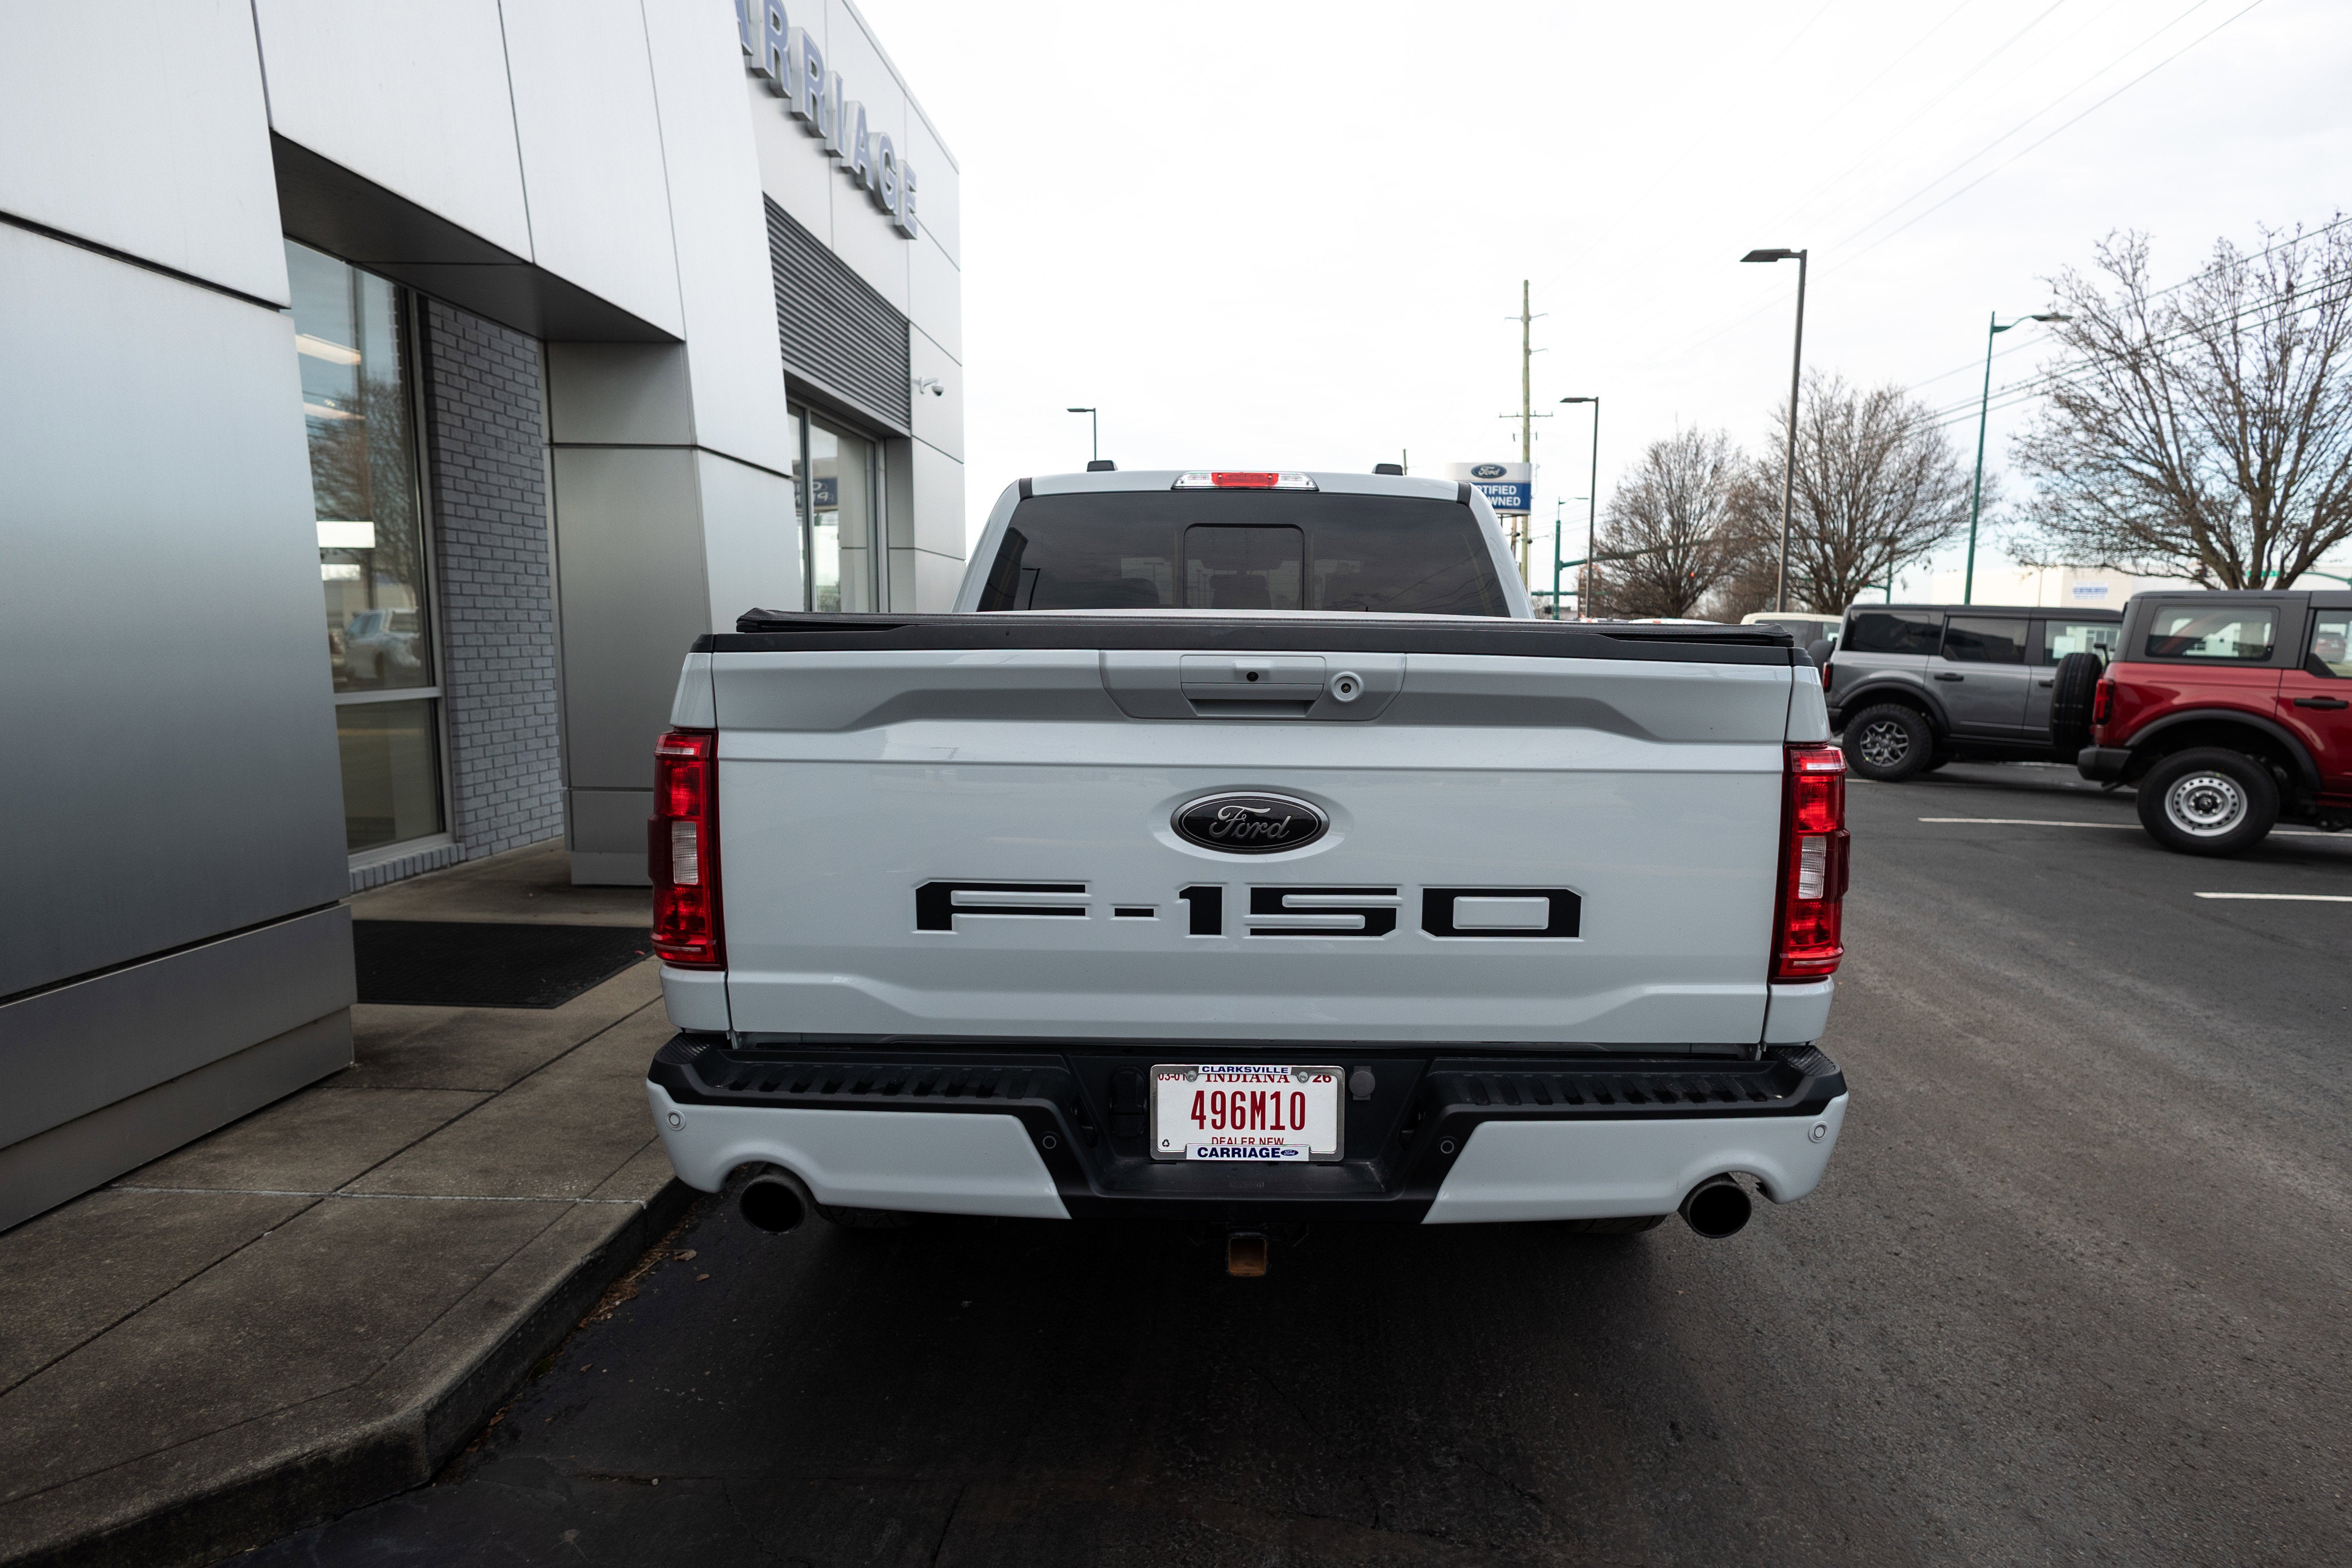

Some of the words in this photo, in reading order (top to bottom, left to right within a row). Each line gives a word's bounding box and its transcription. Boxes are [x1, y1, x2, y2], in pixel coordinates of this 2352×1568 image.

[1478, 466, 1501, 476] Ford
[1209, 805, 1292, 839] Ford
[915, 881, 1581, 939] F-150
[1205, 1074, 1290, 1084] INDIANA
[1312, 1075, 1332, 1084] 26
[1191, 1090, 1306, 1131] 496M10
[1197, 1147, 1281, 1158] CARRIAGE
